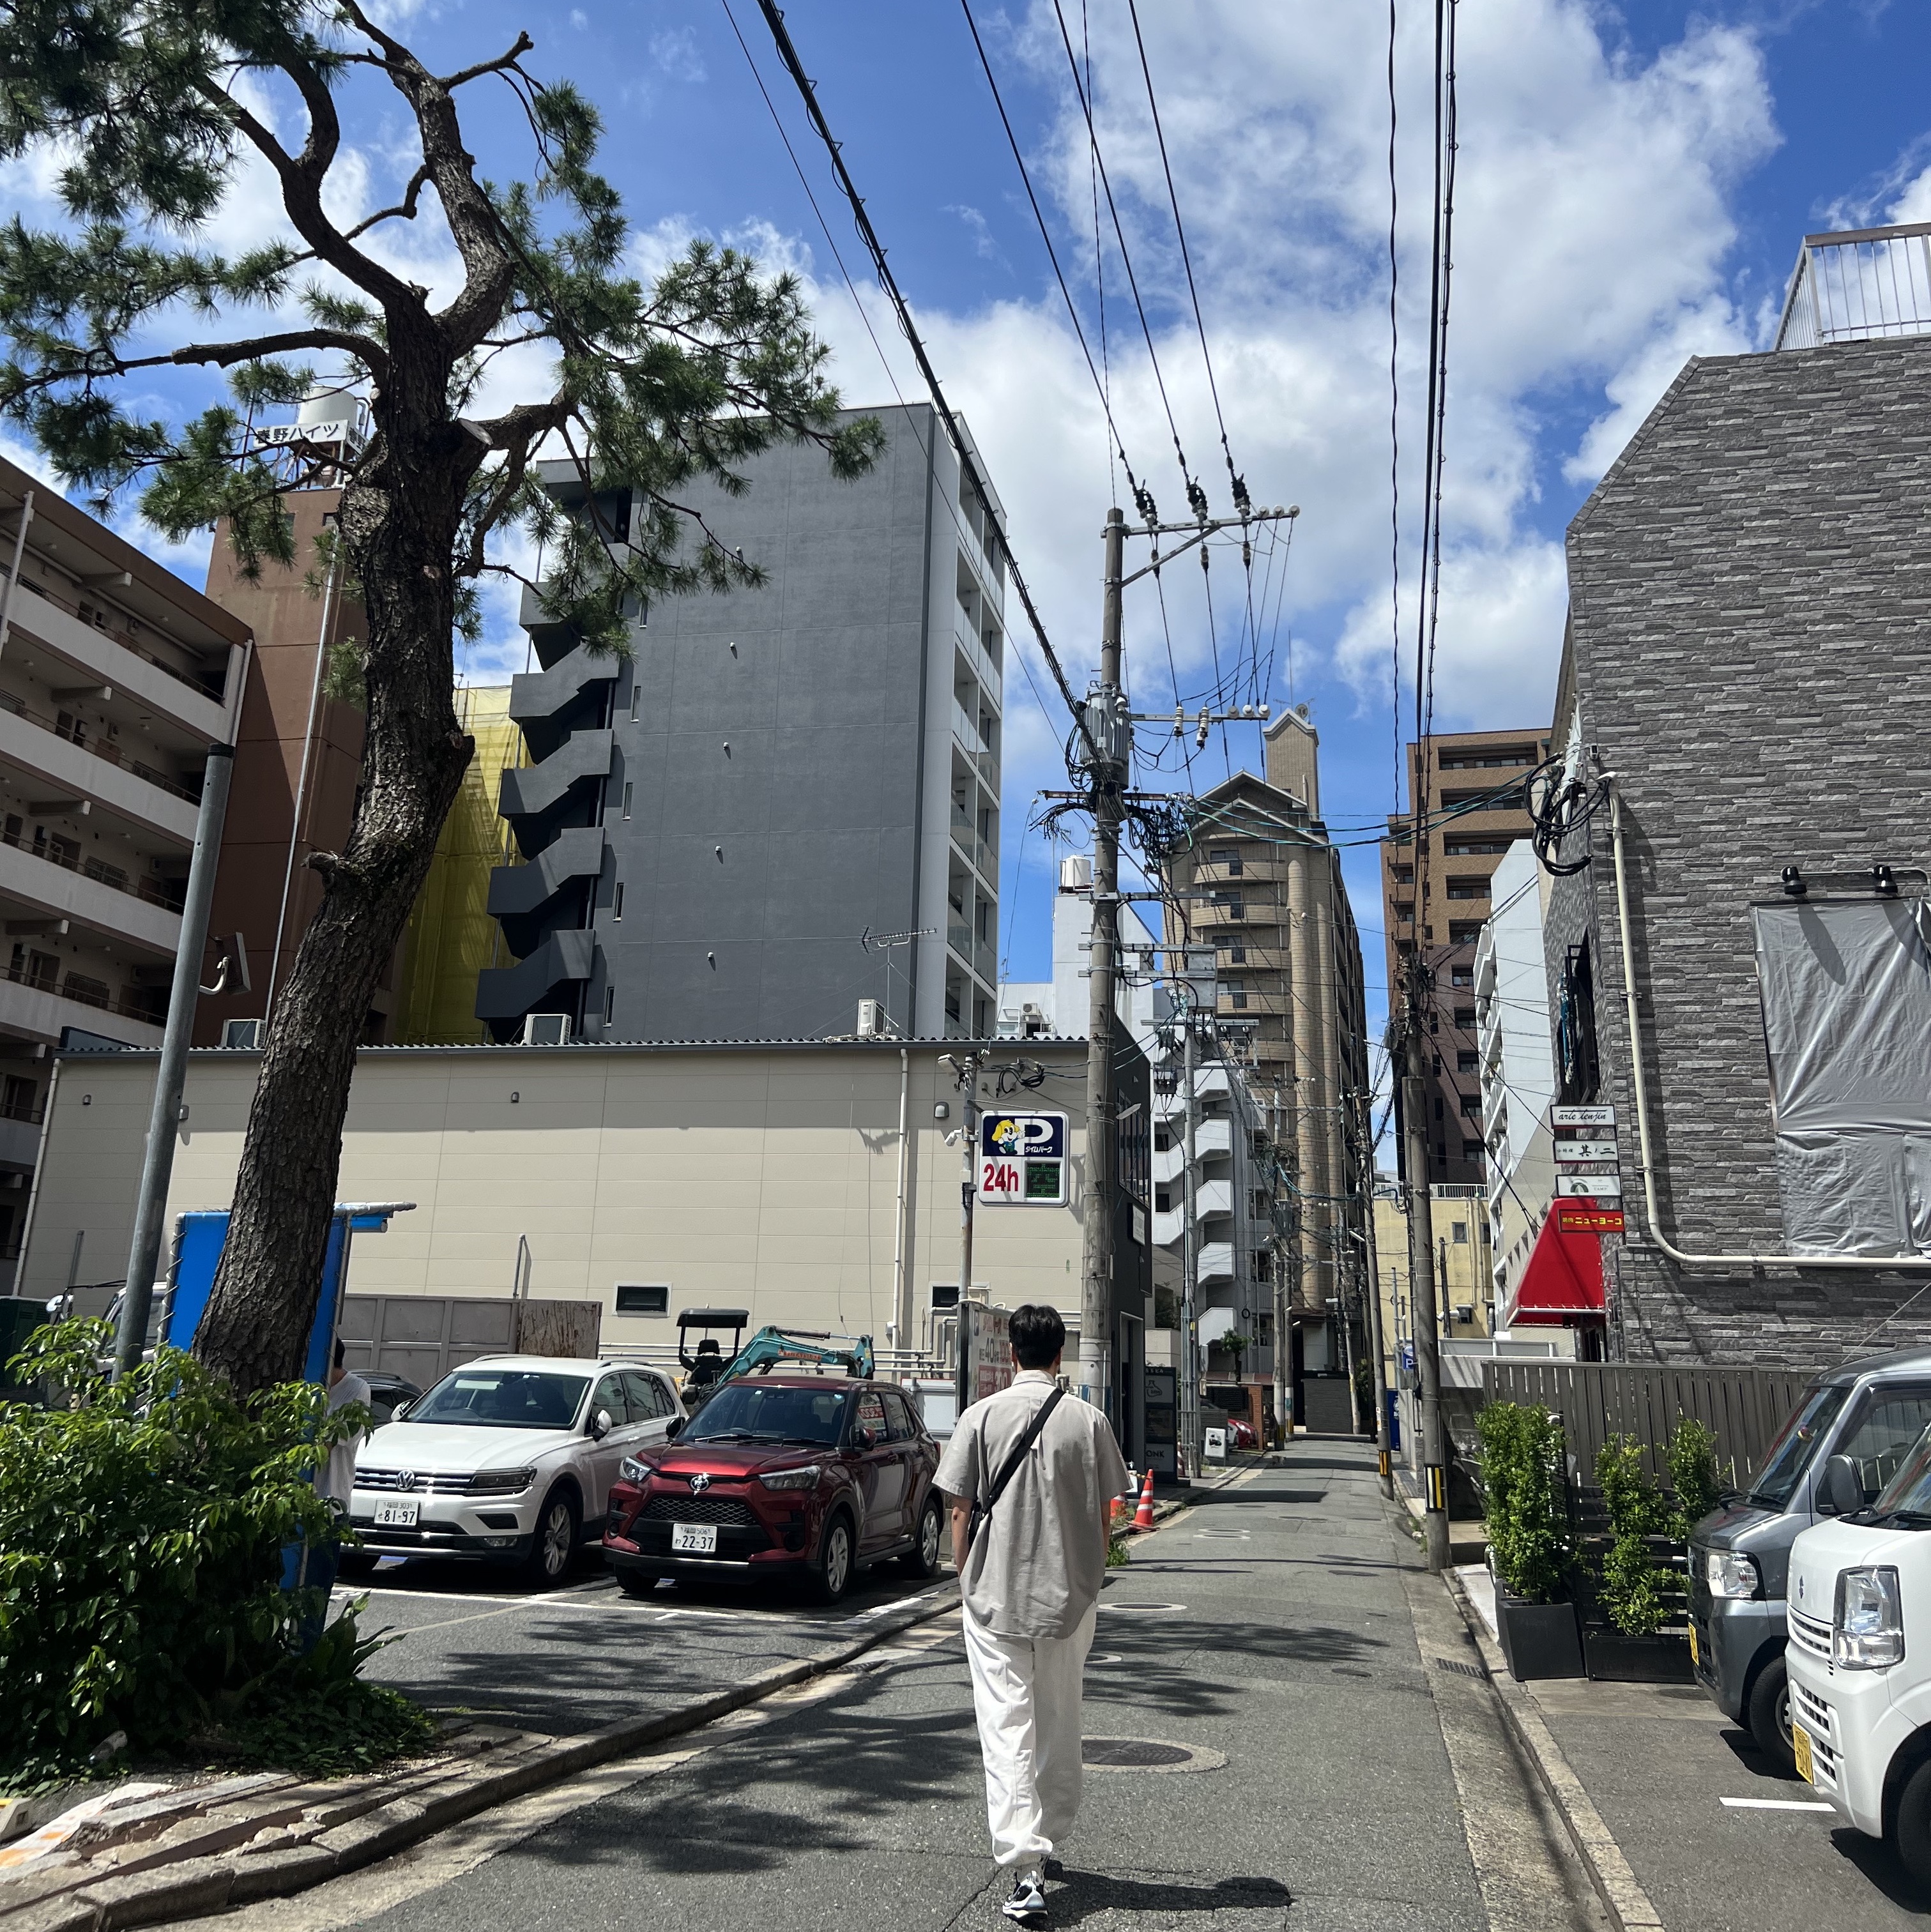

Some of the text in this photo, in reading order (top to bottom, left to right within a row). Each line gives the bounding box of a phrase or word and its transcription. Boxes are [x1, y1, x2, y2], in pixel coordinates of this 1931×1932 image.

[1014, 1118, 1053, 1155] P
[983, 1164, 1019, 1192] 24h
[385, 1509, 415, 1523] 81-97
[682, 1535, 714, 1549] 22-37
